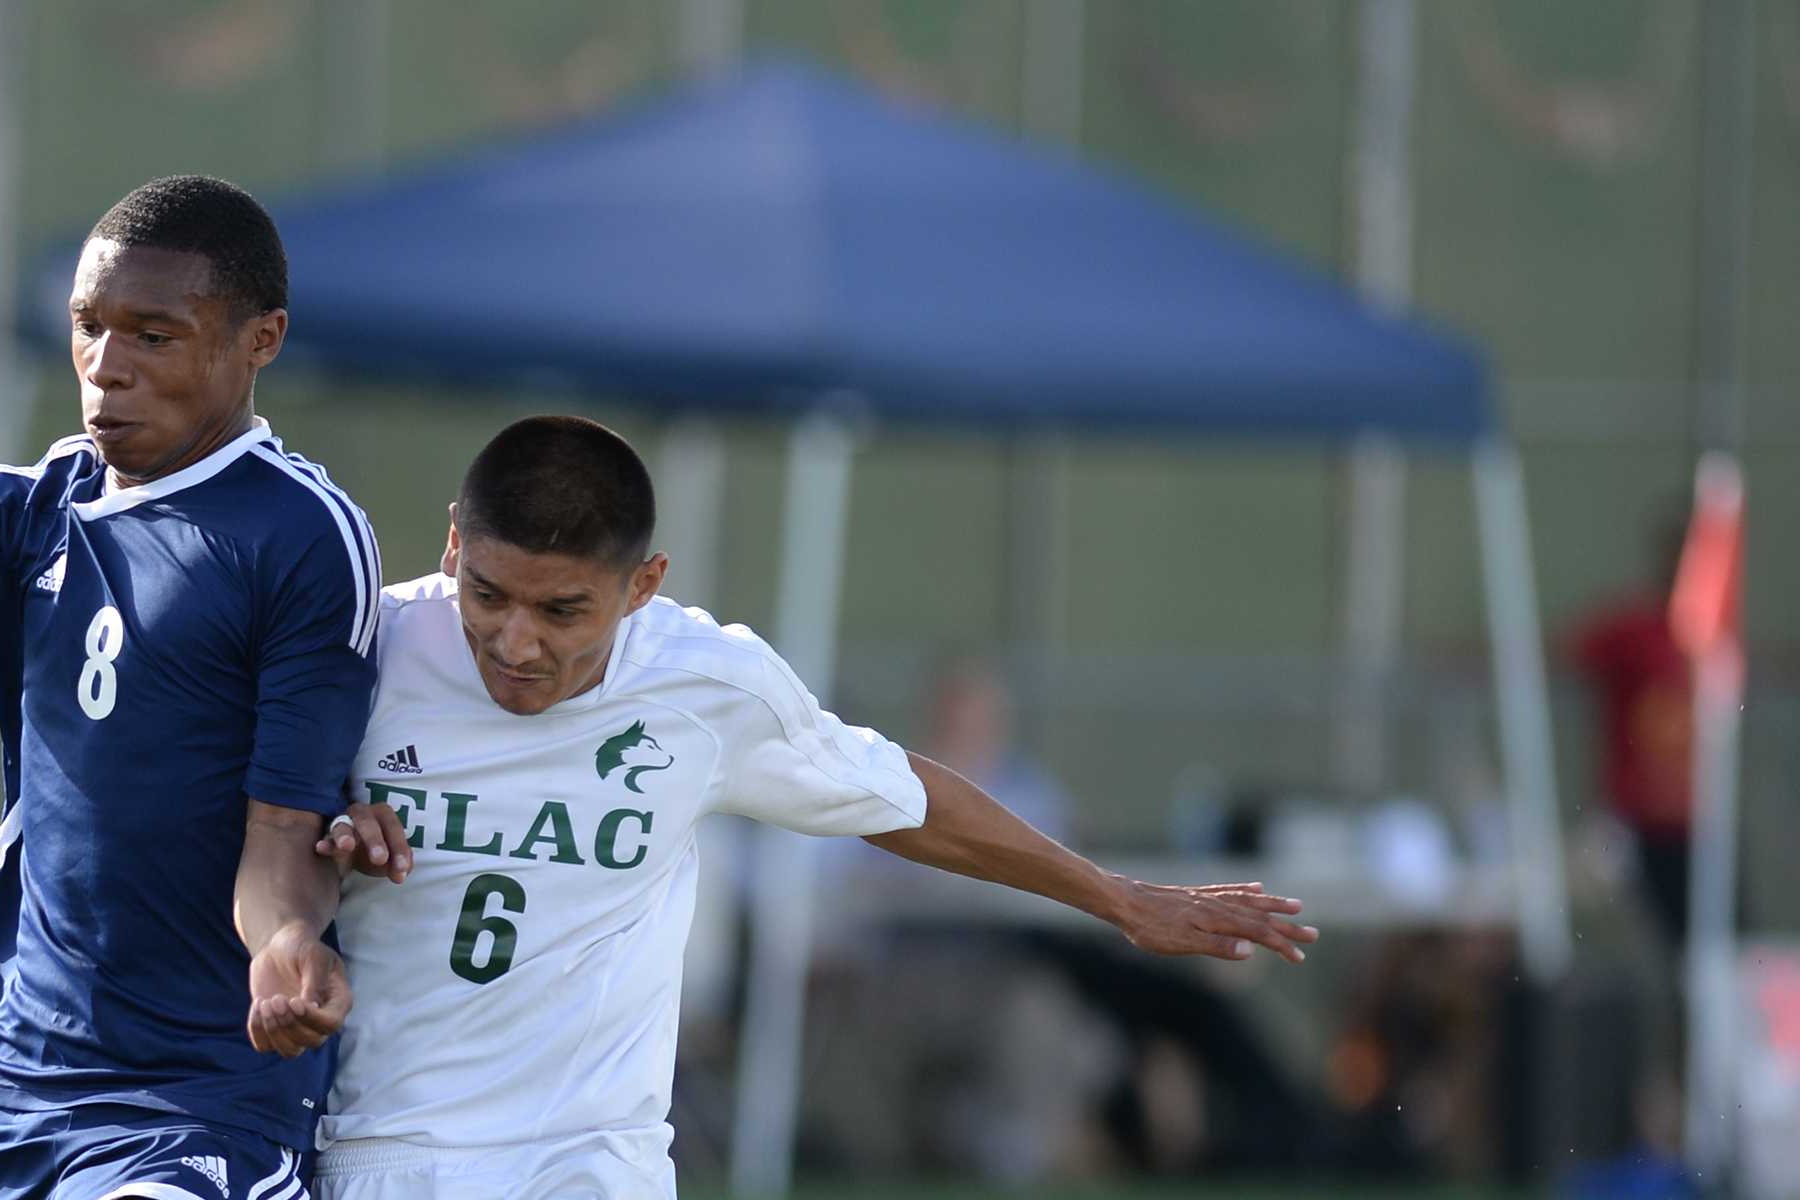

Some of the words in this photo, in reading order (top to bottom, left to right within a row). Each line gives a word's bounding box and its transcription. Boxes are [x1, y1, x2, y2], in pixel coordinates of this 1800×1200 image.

[77, 605, 124, 720] 8
[364, 780, 654, 870] ELAC
[449, 873, 527, 985] 6
[180, 1156, 230, 1200] adidas
